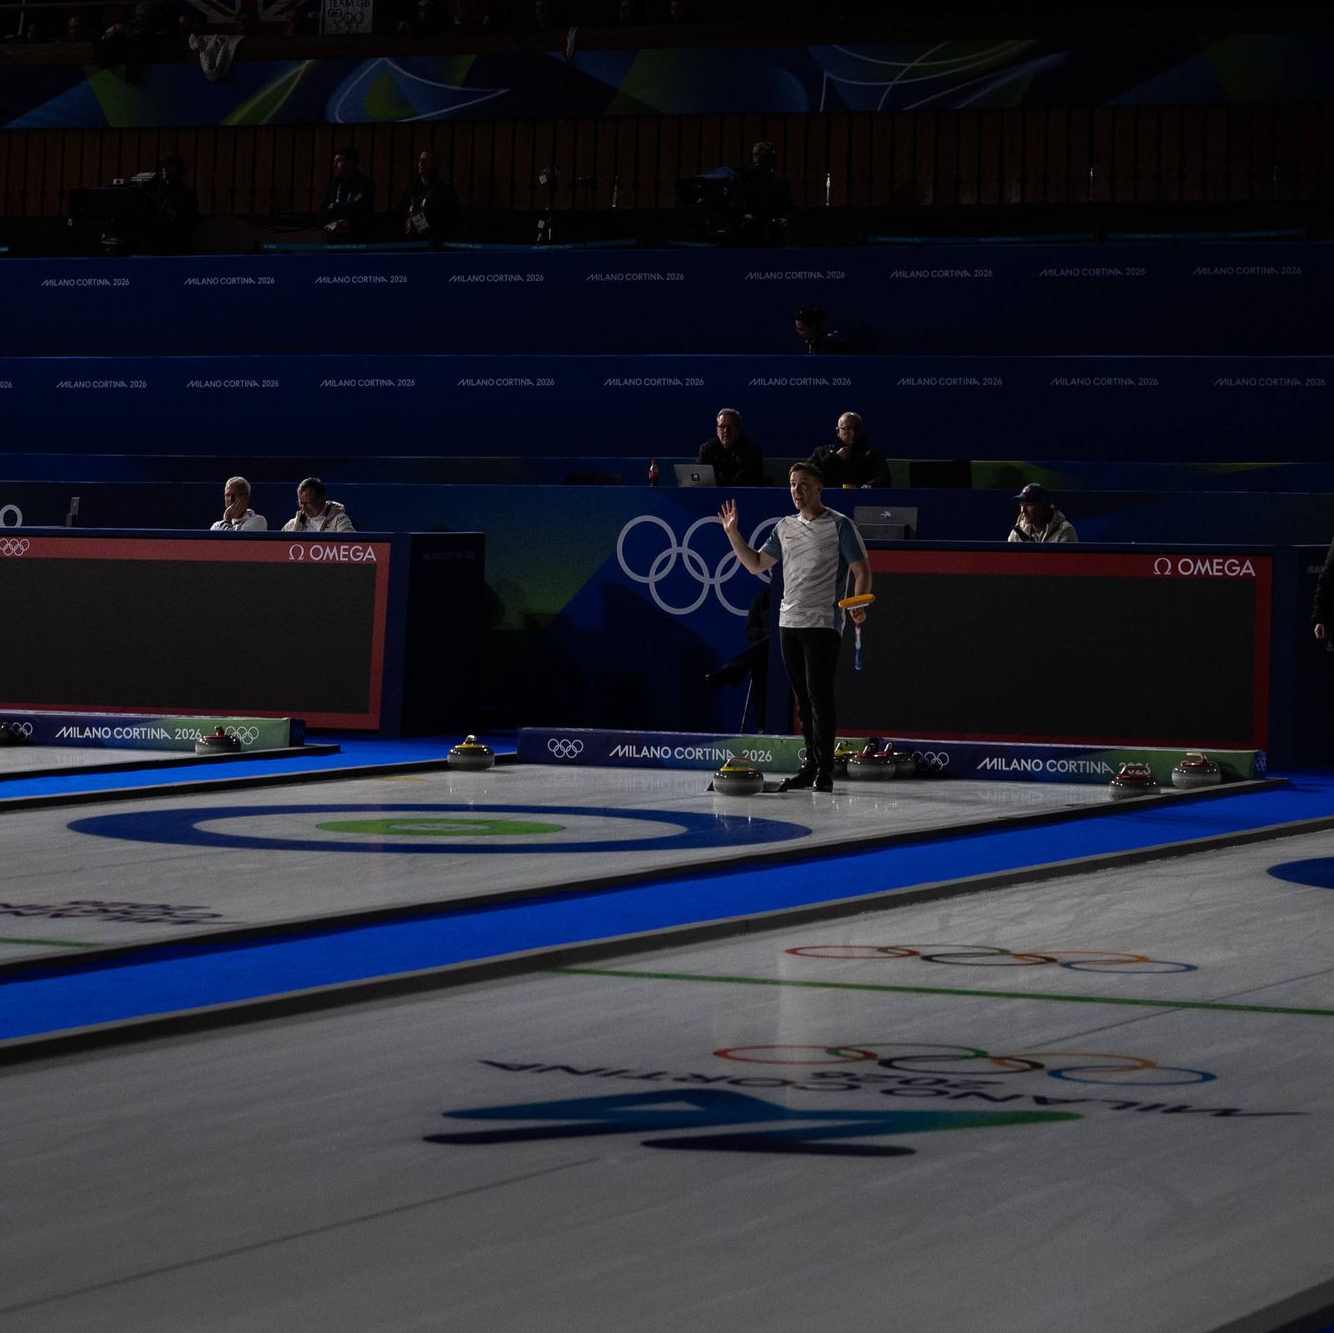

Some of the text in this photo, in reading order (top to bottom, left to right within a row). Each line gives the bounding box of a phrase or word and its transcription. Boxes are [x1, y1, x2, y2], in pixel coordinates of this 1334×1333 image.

[329, 0, 354, 7] TEAM
[890, 270, 930, 278] MILANO
[973, 269, 994, 277] 2026
[1081, 268, 1124, 276] CORTINA
[1125, 267, 1146, 276] 2026
[1193, 267, 1235, 275] MILANO
[1281, 266, 1302, 274] 2026
[486, 274, 525, 282] CORTINA
[526, 274, 545, 282] 2026
[665, 273, 684, 281] 2026
[784, 271, 825, 279] CORTINA
[826, 271, 845, 279] 2026
[113, 278, 131, 286] 2026
[92, 380, 128, 388] CORTINA
[129, 380, 147, 388] 2026
[186, 380, 222, 388] MILANO
[320, 379, 357, 387] MILANO
[397, 379, 416, 387] 2026
[496, 378, 535, 386] CORTINA
[536, 378, 555, 386] 2026
[604, 378, 704, 386] MILANO CORTINA 2026
[748, 378, 851, 386] MILANO CORTINA 2026
[938, 377, 981, 385] CORTINA
[982, 377, 1002, 386] 2026
[1092, 377, 1137, 385] CORTINA
[1138, 378, 1159, 386] 2026
[1213, 378, 1327, 386] MILANO CORTINA 2026
[309, 545, 376, 561] OMEGA
[1177, 558, 1256, 577] OMEGA
[55, 726, 202, 740] MILANO CORTINA 2026
[609, 744, 772, 763] MILANO CORTINA 2026
[976, 757, 1042, 772] MILANO
[1046, 759, 1115, 775] CORTINA
[812, 1071, 1004, 1089] 2026
[477, 1059, 1311, 1117] MILANO CORTINA
